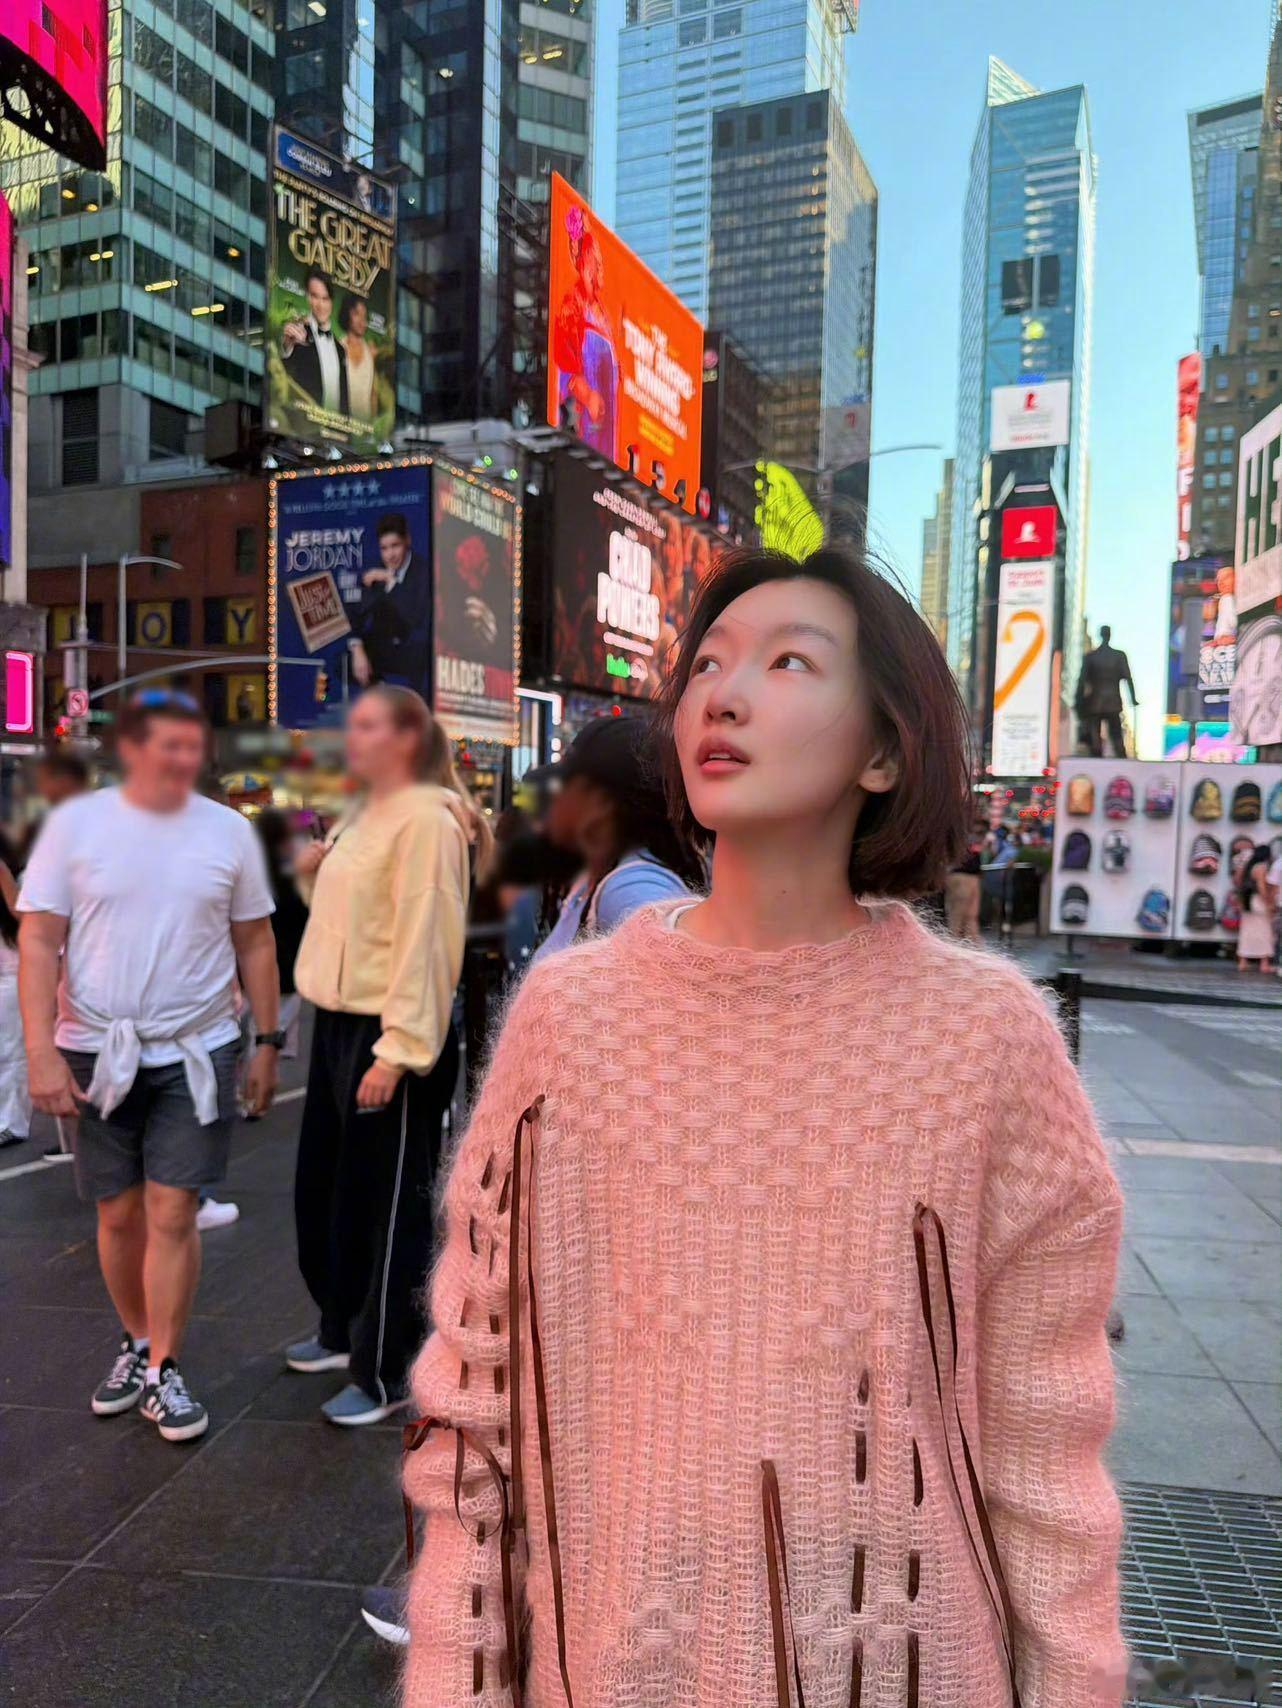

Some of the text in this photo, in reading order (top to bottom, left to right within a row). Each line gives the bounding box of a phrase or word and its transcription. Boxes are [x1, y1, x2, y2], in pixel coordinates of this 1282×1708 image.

[276, 189, 394, 271] THE GREAT
[288, 228, 381, 293] GATSBY
[285, 527, 365, 548] JEREMY
[285, 543, 364, 574] JORDAN
